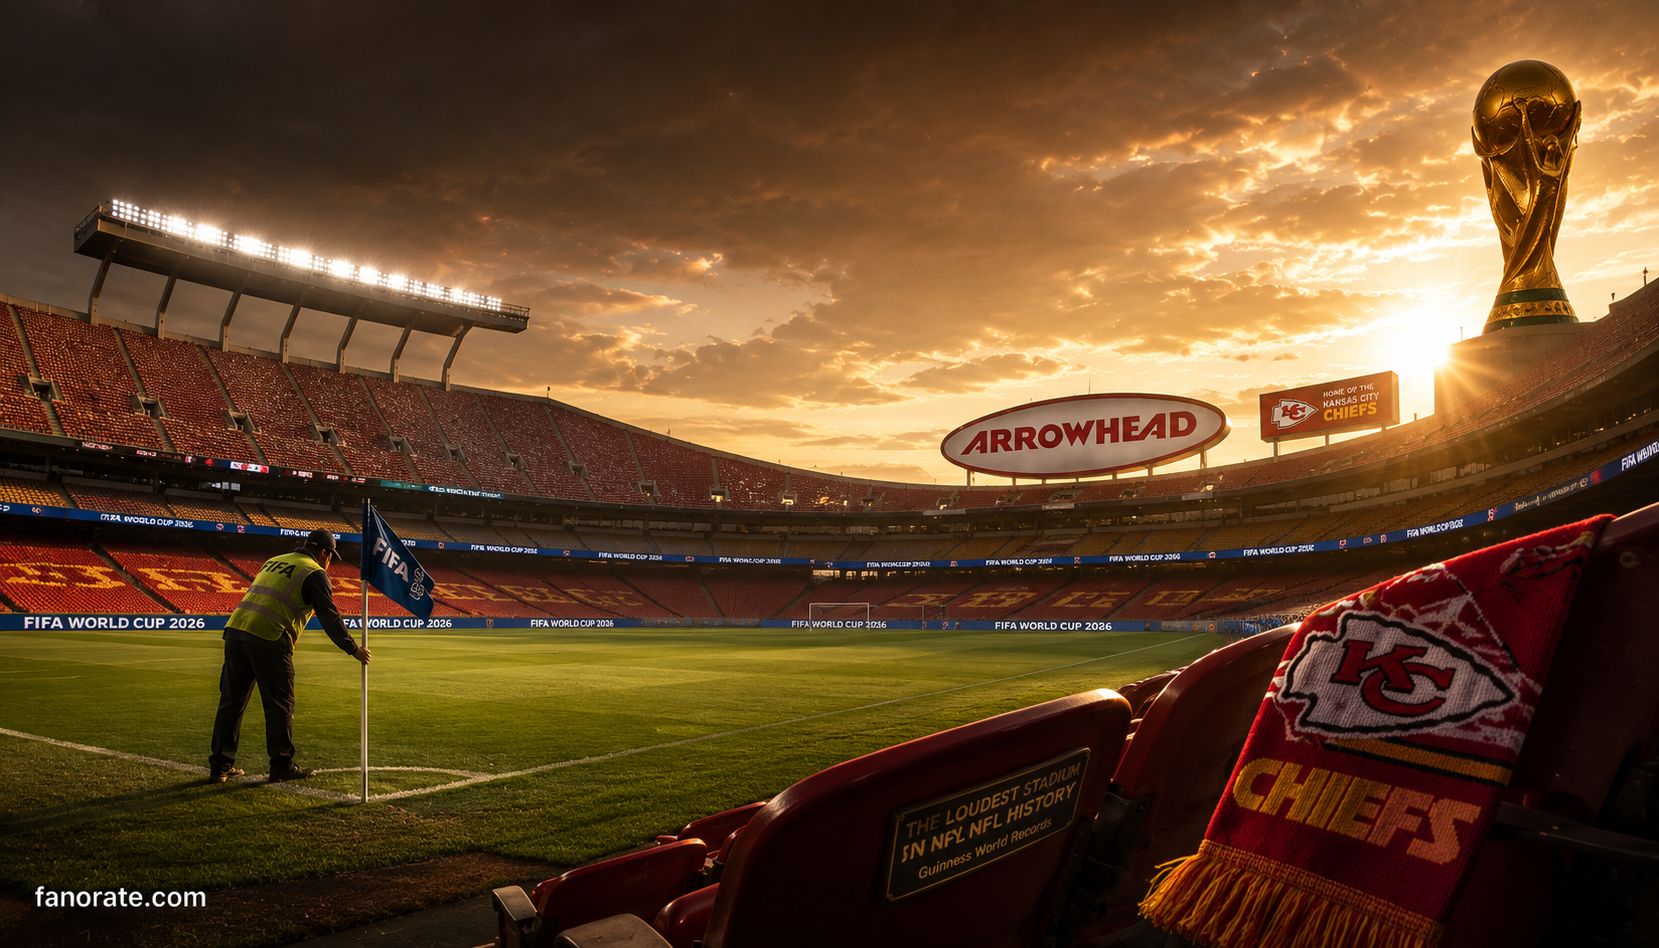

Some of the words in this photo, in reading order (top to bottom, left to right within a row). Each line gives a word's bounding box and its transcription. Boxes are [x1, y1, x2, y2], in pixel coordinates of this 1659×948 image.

[1323, 397, 1358, 408] KANSAS
[1360, 392, 1379, 402] CITY
[1323, 402, 1377, 421] CHIEFS
[960, 410, 1197, 456] ARROWHEAD
[372, 537, 408, 583] FIFA
[261, 561, 296, 579] FIFA
[24, 616, 63, 629] FIFA
[68, 617, 129, 629] WORLD
[133, 617, 165, 629] CUP
[169, 617, 205, 629] 2026
[403, 618, 424, 629] CUP
[427, 618, 452, 629] 2026
[530, 619, 549, 628] FIFA
[551, 619, 579, 628] WORLD
[580, 619, 595, 628] CUP
[812, 620, 843, 629] WORLD
[845, 620, 863, 629] CUP
[994, 621, 1017, 630] FIFA
[1019, 621, 1058, 630] WORLD
[1060, 621, 1082, 631] CUP
[1330, 640, 1455, 716] KC
[906, 813, 941, 838] THE
[945, 785, 1021, 826] LOUDEST
[1023, 762, 1081, 797] STADIUM
[969, 813, 1003, 839] NFL
[1006, 781, 1077, 824] HISTORY
[1232, 757, 1482, 866] CHIEFS
[918, 852, 972, 879] Guinness
[975, 834, 1009, 858] World
[1011, 817, 1052, 844] Records
